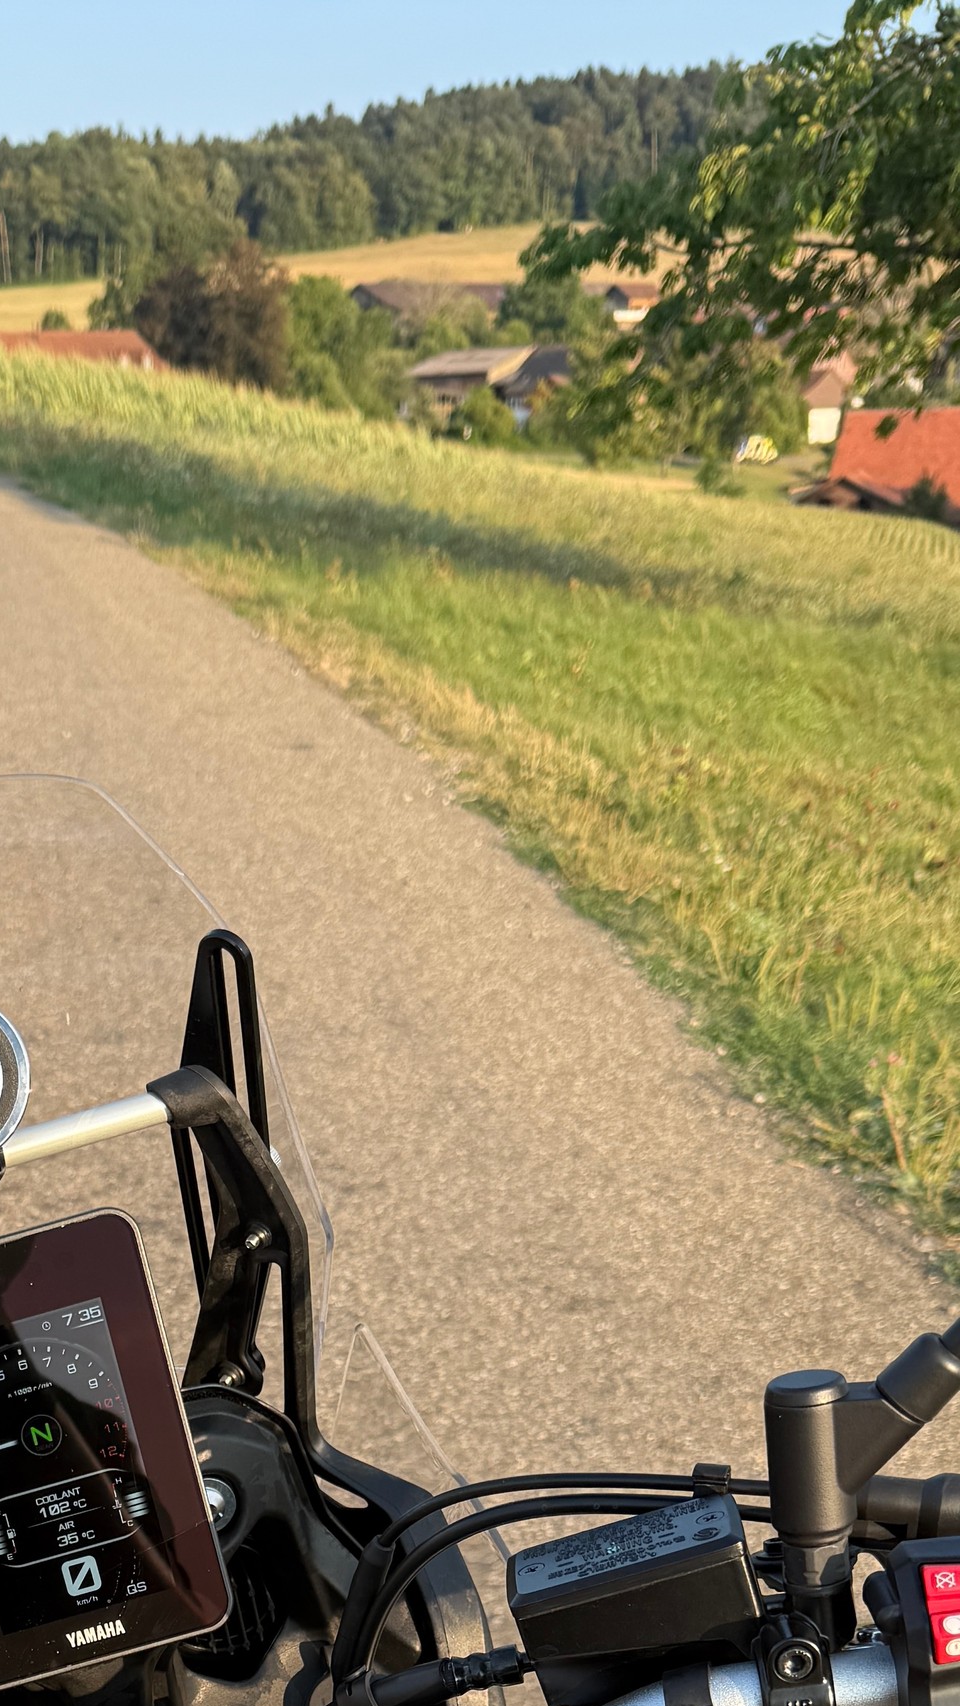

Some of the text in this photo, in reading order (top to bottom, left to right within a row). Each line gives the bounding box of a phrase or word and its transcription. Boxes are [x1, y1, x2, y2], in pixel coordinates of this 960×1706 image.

[17, 1359, 29, 1371] 6
[42, 1356, 52, 1368] 7
[66, 1363, 77, 1375] 8
[88, 1378, 99, 1389] 9
[104, 1421, 121, 1433] 11
[30, 1422, 53, 1446] N
[100, 1446, 118, 1457] 12
[114, 1477, 123, 1485] H
[35, 1486, 82, 1506] COOLANT
[39, 1500, 72, 1519] 102
[58, 1520, 76, 1532] AIR
[56, 1531, 80, 1548] 35
[582, 1536, 654, 1562] WANING
[7, 1553, 14, 1561] E
[61, 1555, 103, 1597] 0
[126, 1581, 148, 1596] QS
[76, 1595, 99, 1606] km/h
[65, 1619, 127, 1648] YAMAHA
